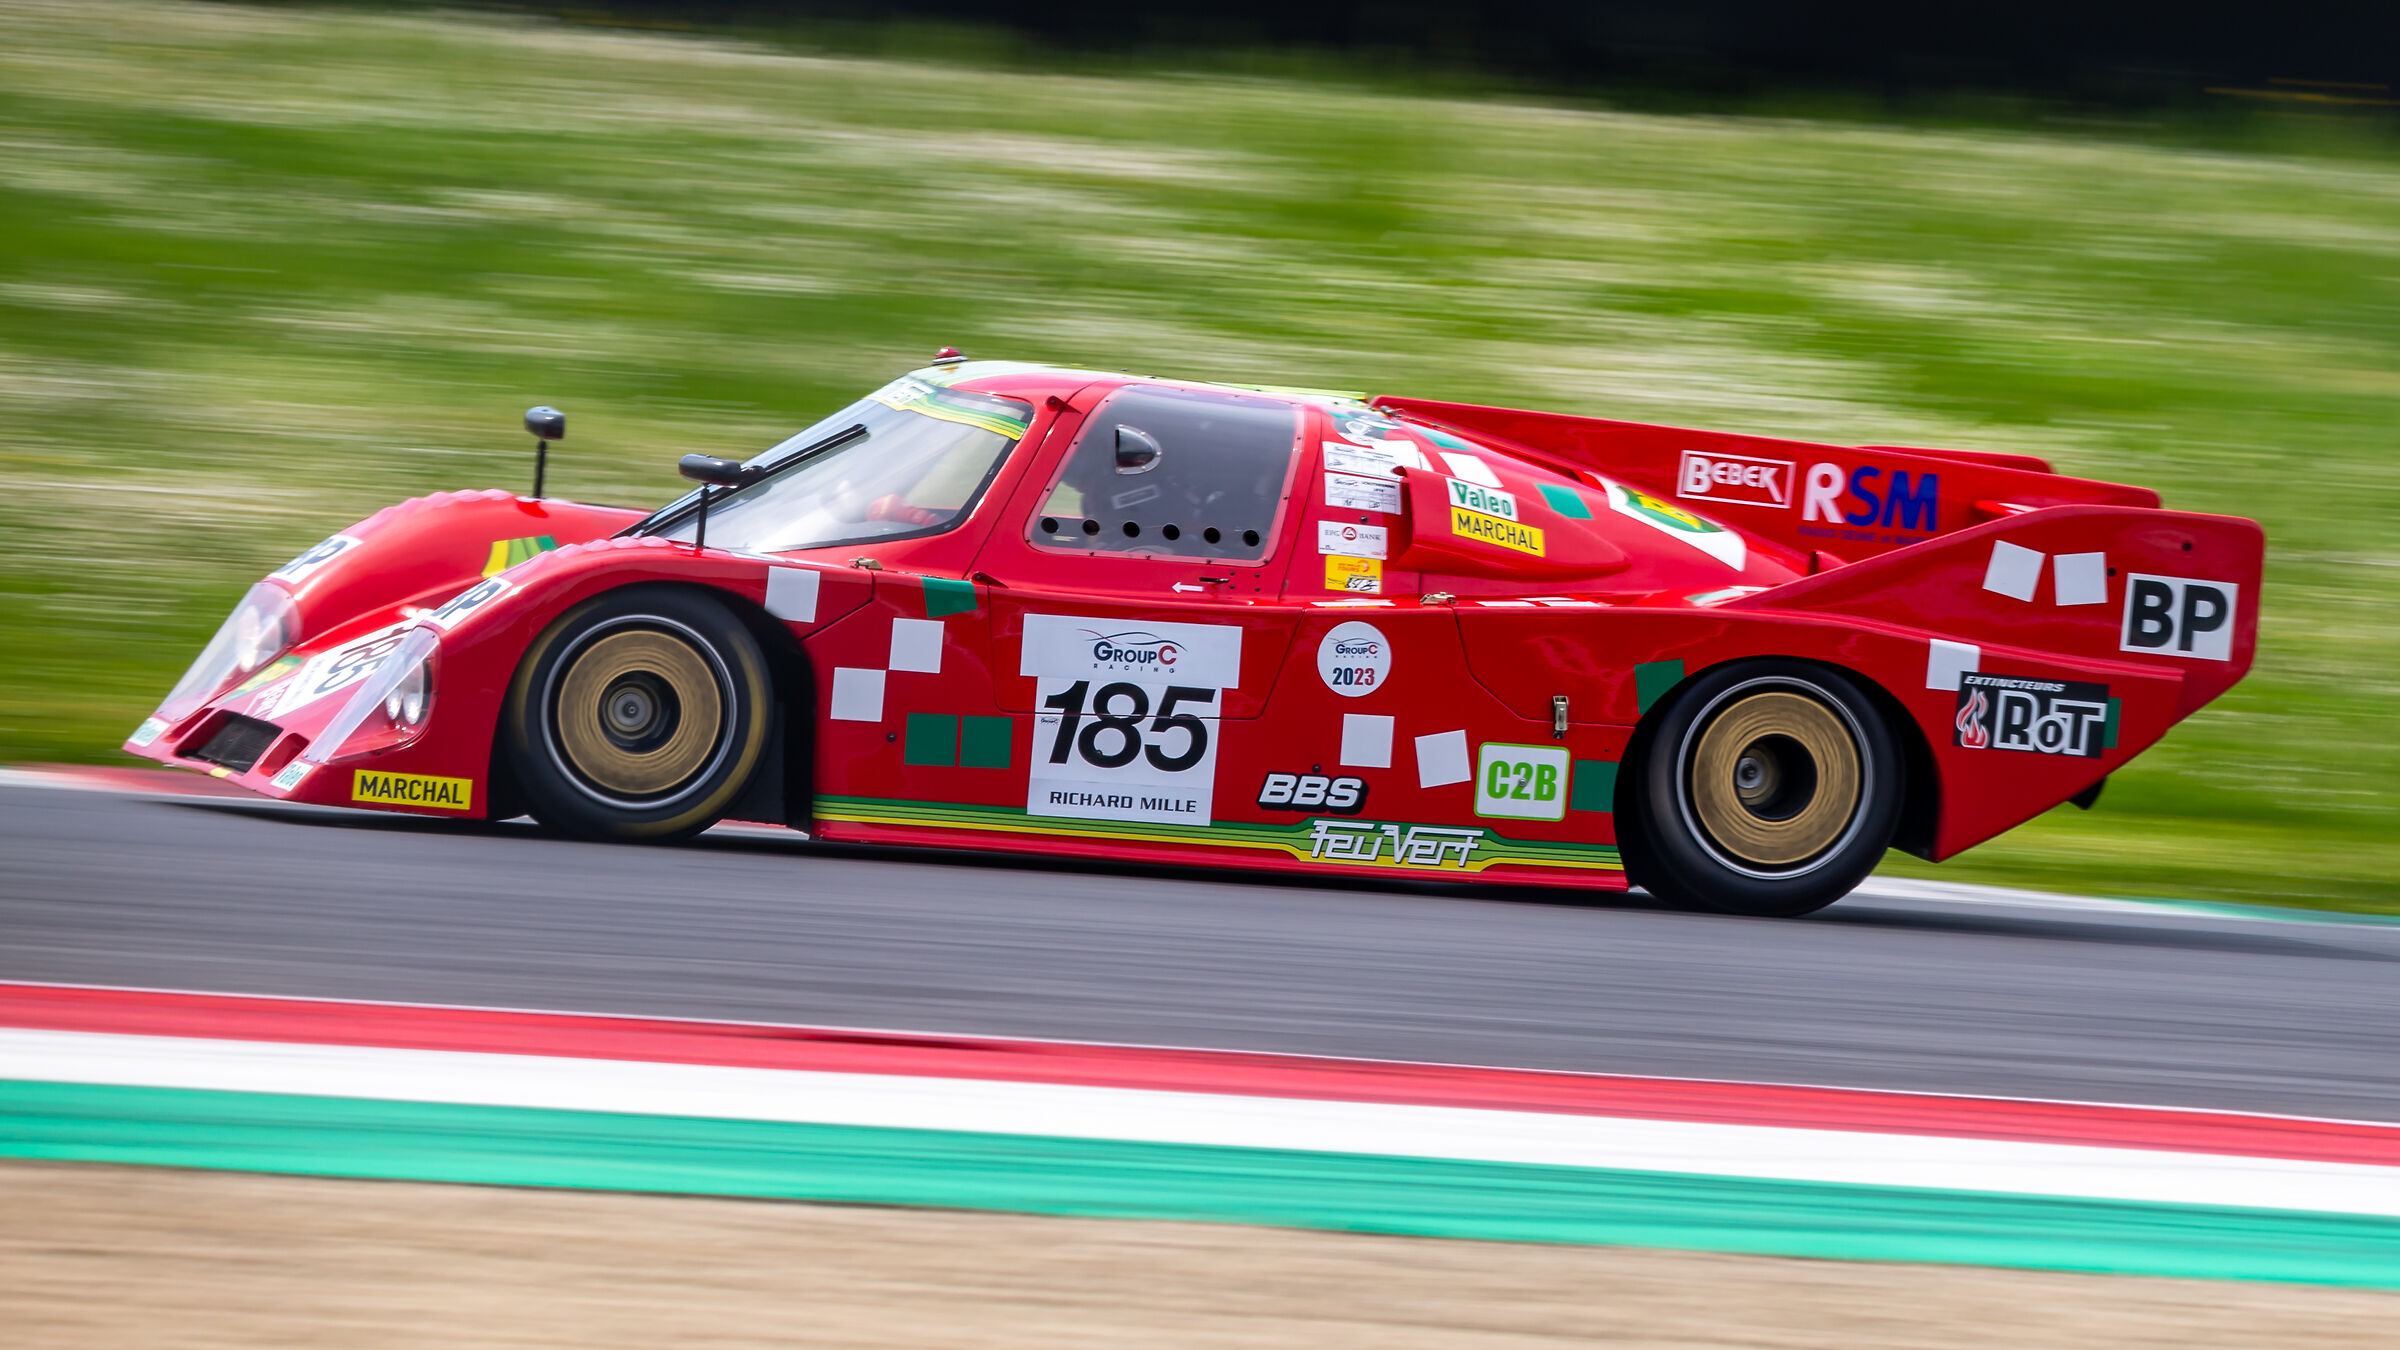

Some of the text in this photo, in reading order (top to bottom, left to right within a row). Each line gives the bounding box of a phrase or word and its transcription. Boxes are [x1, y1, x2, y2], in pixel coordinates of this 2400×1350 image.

[1451, 481, 1512, 516] Valeo
[1801, 462, 1939, 532] RSM
[1457, 512, 1538, 551] MARCHAL
[2126, 578, 2228, 651] BP
[1093, 663, 1175, 673] RACING
[1332, 667, 1375, 686] 2023
[1964, 675, 2066, 693] EXTINCTEURS
[1044, 680, 1217, 772] 185
[359, 775, 464, 805] MARCHAL
[1257, 772, 1364, 810] BBS
[1486, 760, 1557, 802] C2B
[1050, 791, 1197, 813] RICHARD MILLE
